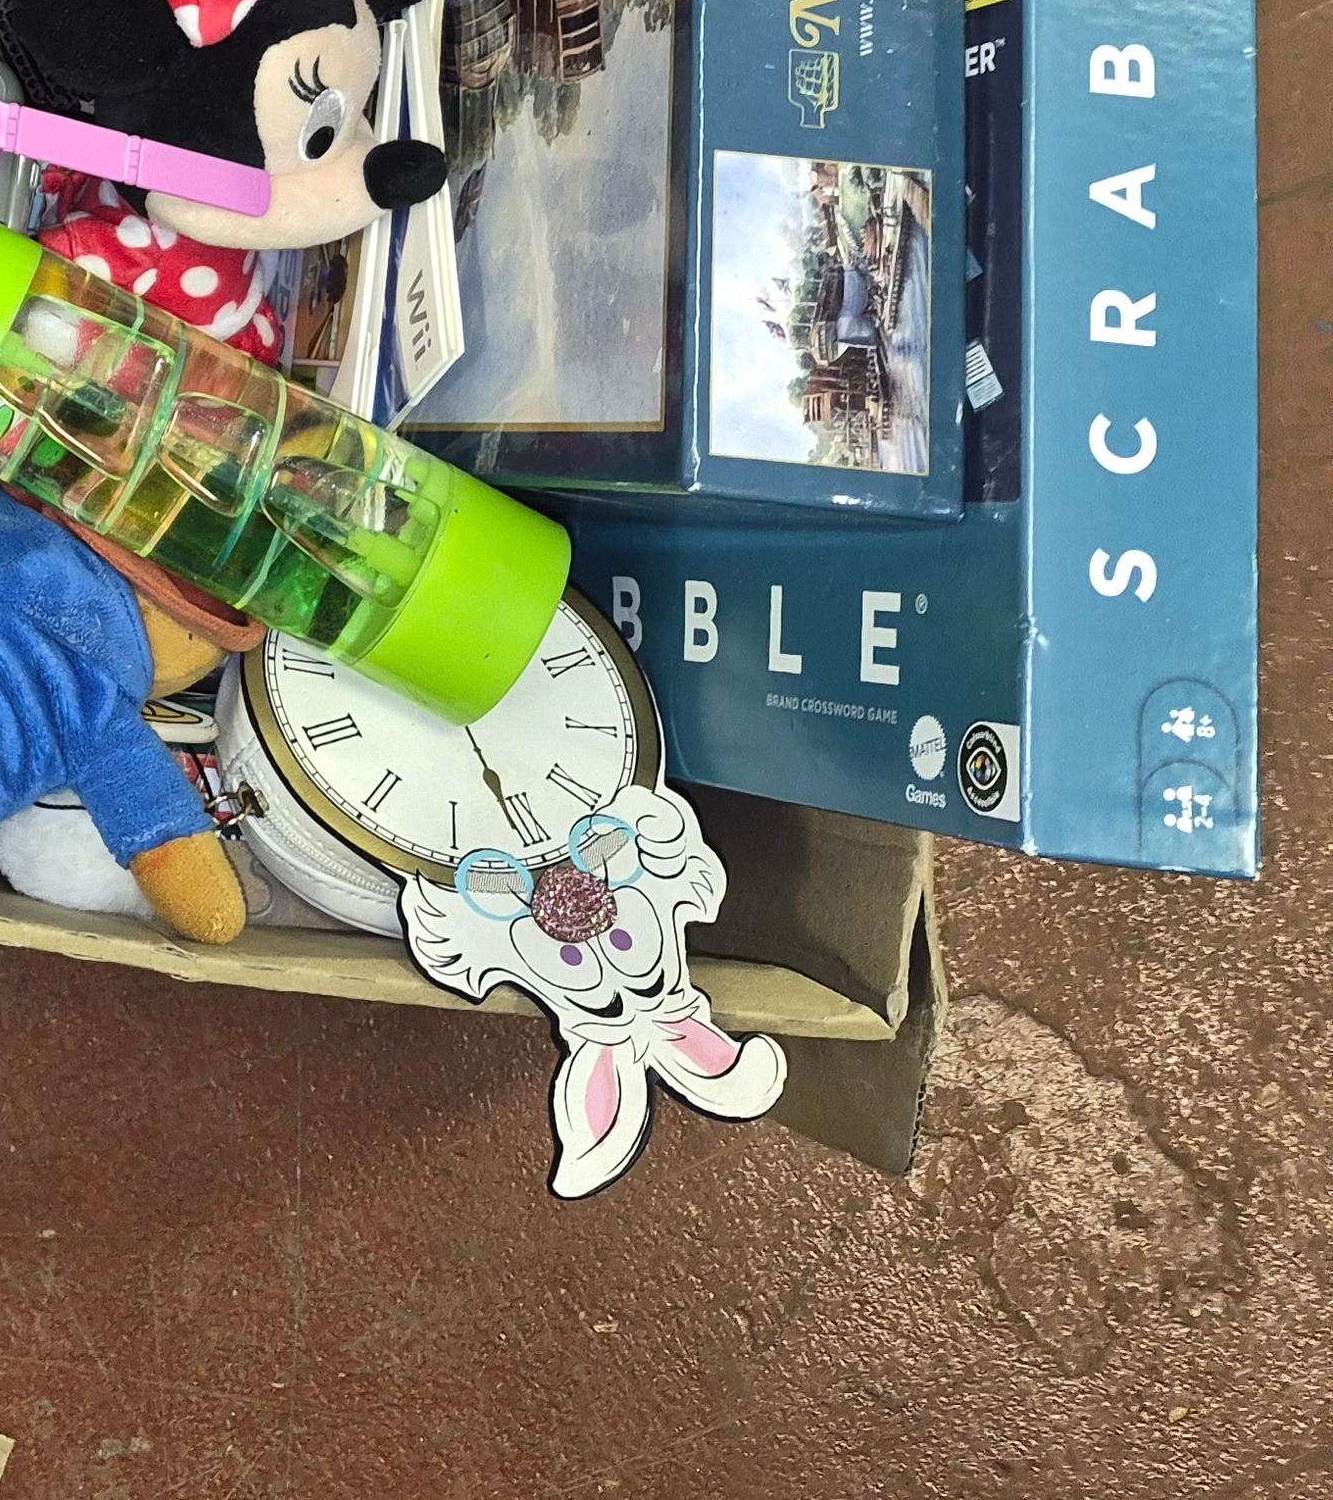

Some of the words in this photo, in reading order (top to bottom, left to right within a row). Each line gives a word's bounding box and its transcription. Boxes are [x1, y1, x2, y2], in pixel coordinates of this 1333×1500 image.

[406, 267, 433, 365] Wii
[765, 692, 799, 711] BRAND
[800, 698, 865, 720] CROSSWORD
[867, 706, 898, 725] GAME
[1196, 714, 1216, 739] 8+
[909, 737, 947, 760] MATTEL
[905, 783, 947, 809] Games
